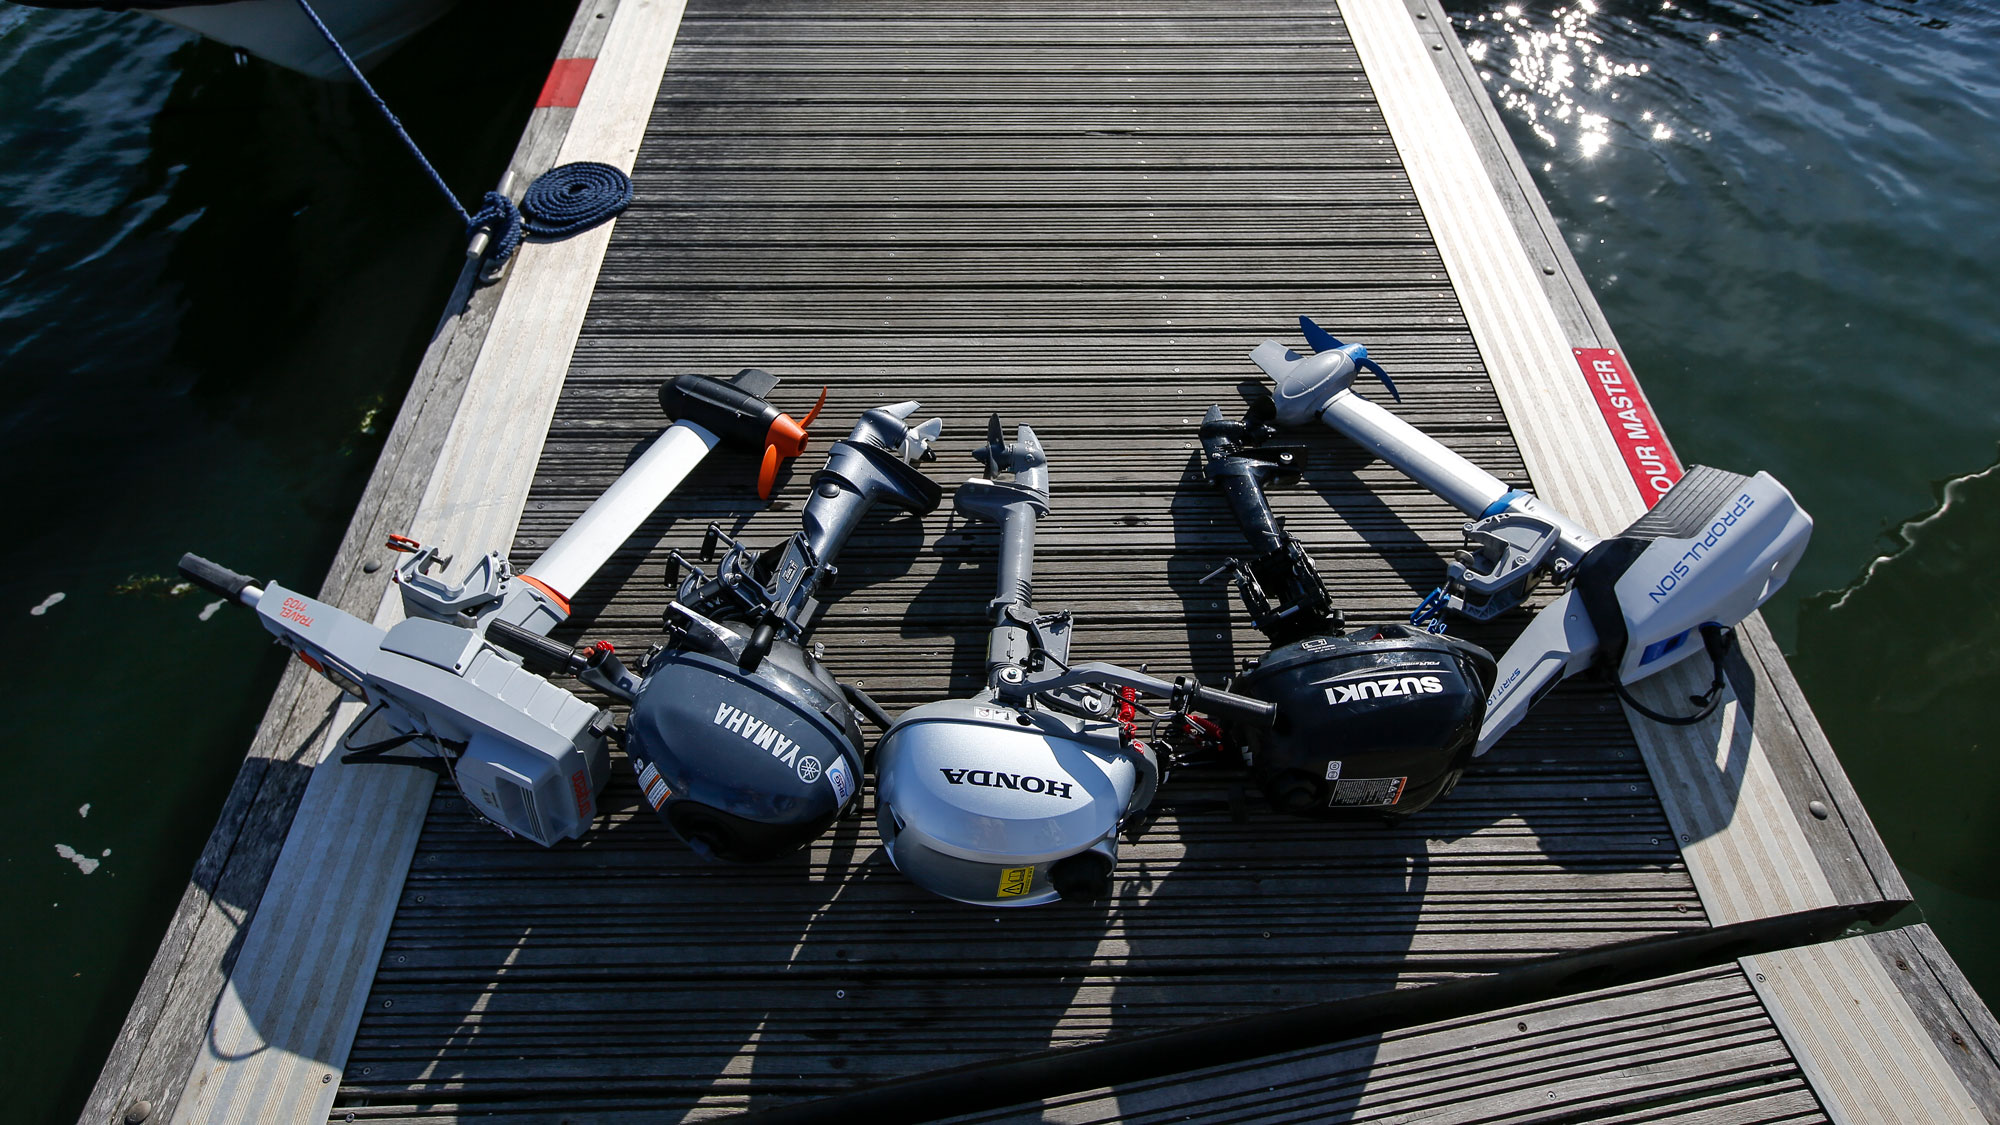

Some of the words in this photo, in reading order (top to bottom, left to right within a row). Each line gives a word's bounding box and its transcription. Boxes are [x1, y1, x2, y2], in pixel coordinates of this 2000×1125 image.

[1592, 360, 1650, 439] MASTER
[1635, 446, 1674, 500] OUR
[1649, 494, 1754, 604] EPROPULSION
[280, 606, 314, 627] TRAVEL
[283, 597, 307, 611] 1103
[1324, 676, 1444, 705] SUZUKI
[1498, 667, 1520, 696] SPIRIT
[713, 702, 802, 769] YAMAHA
[940, 767, 1072, 799] HONDA
